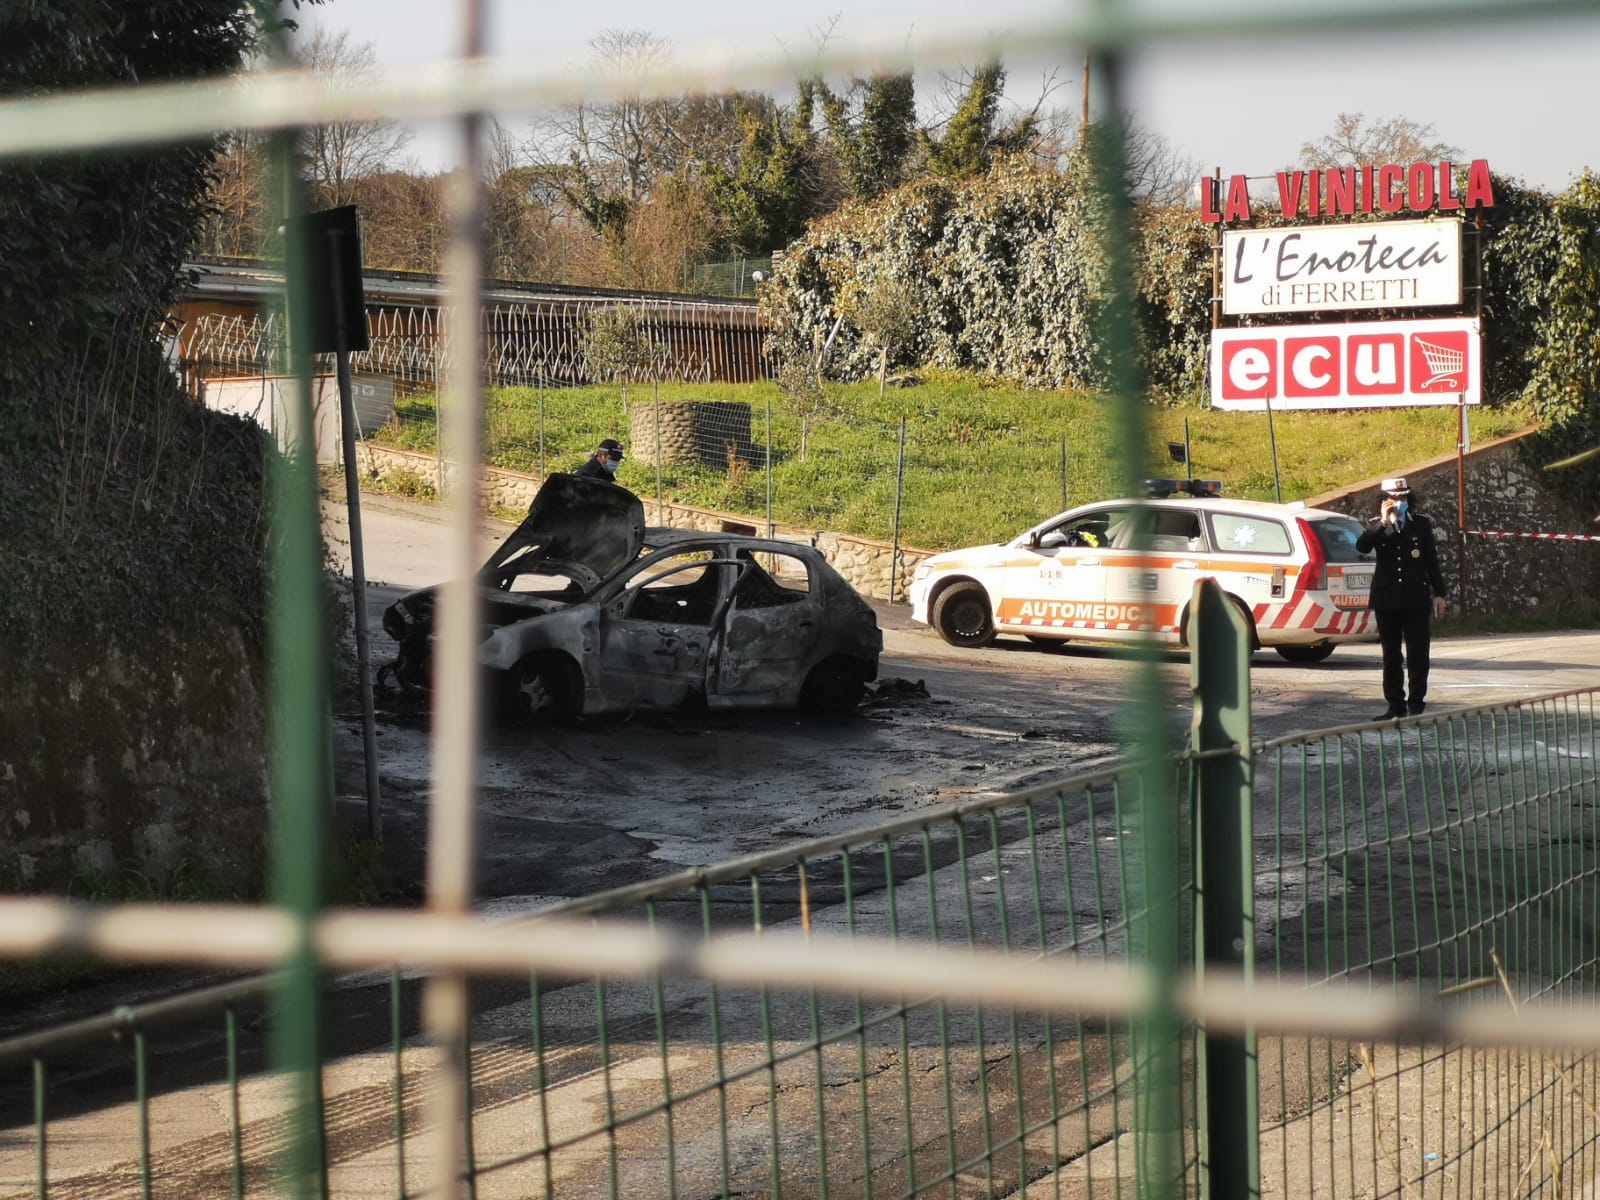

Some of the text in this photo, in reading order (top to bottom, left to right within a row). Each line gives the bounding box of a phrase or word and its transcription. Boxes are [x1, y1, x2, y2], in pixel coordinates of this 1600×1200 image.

[1201, 159, 1494, 223] LA VINICOLA
[1233, 233, 1448, 284] L'Enoteca
[1261, 278, 1418, 306] di FERRETTI
[1228, 343, 1397, 392] ecu
[1020, 601, 1155, 621] AUTOMEDICA
[1333, 595, 1369, 606] AUTOM
